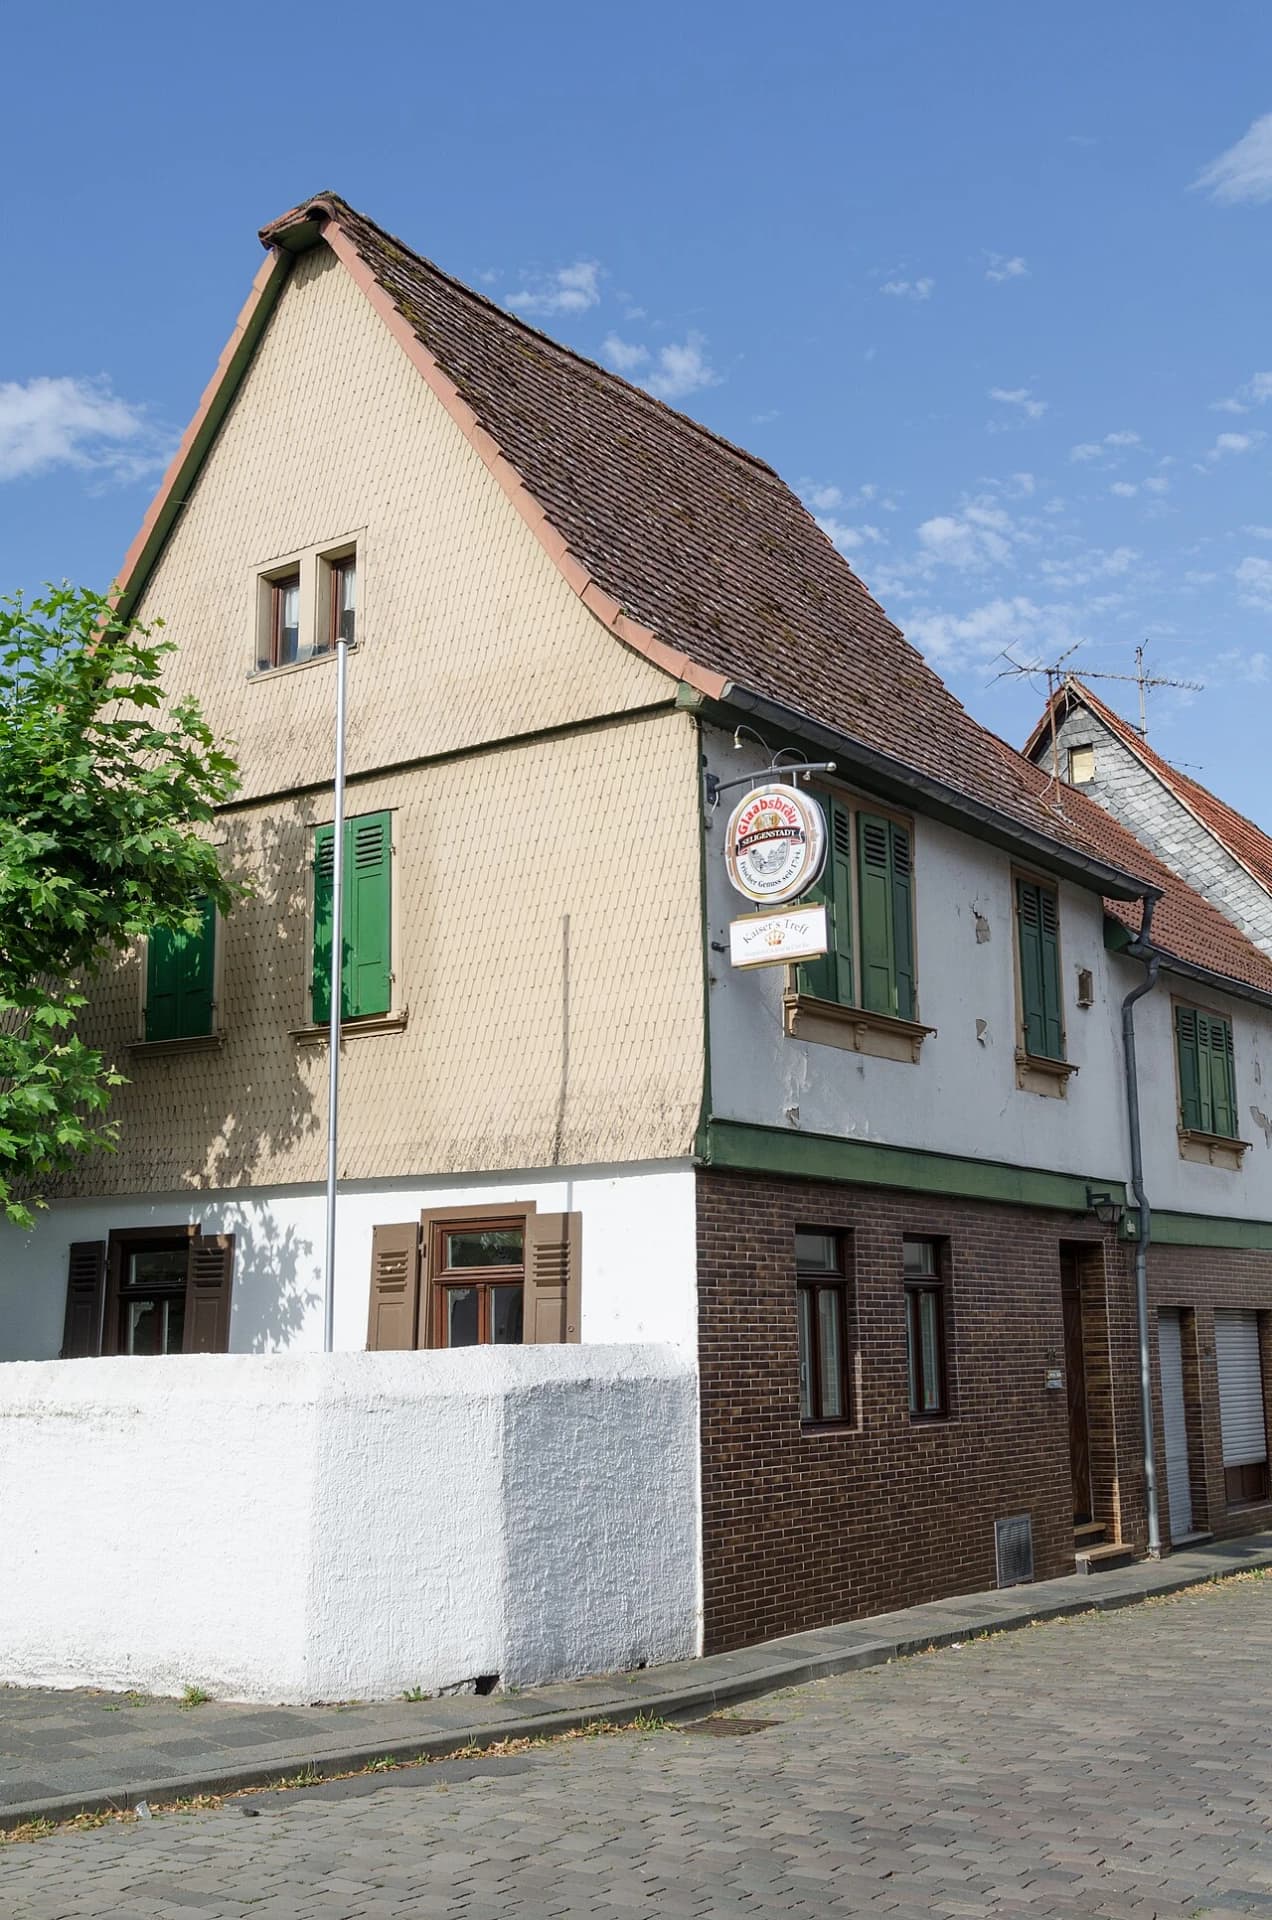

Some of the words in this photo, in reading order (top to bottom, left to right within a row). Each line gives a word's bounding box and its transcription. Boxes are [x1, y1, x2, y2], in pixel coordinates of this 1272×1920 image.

[738, 797, 797, 835] Glaabsbräu
[742, 830, 796, 846] SELIGENSTADT
[743, 920, 780, 944] Kaiser's
[784, 919, 808, 935] Treff
